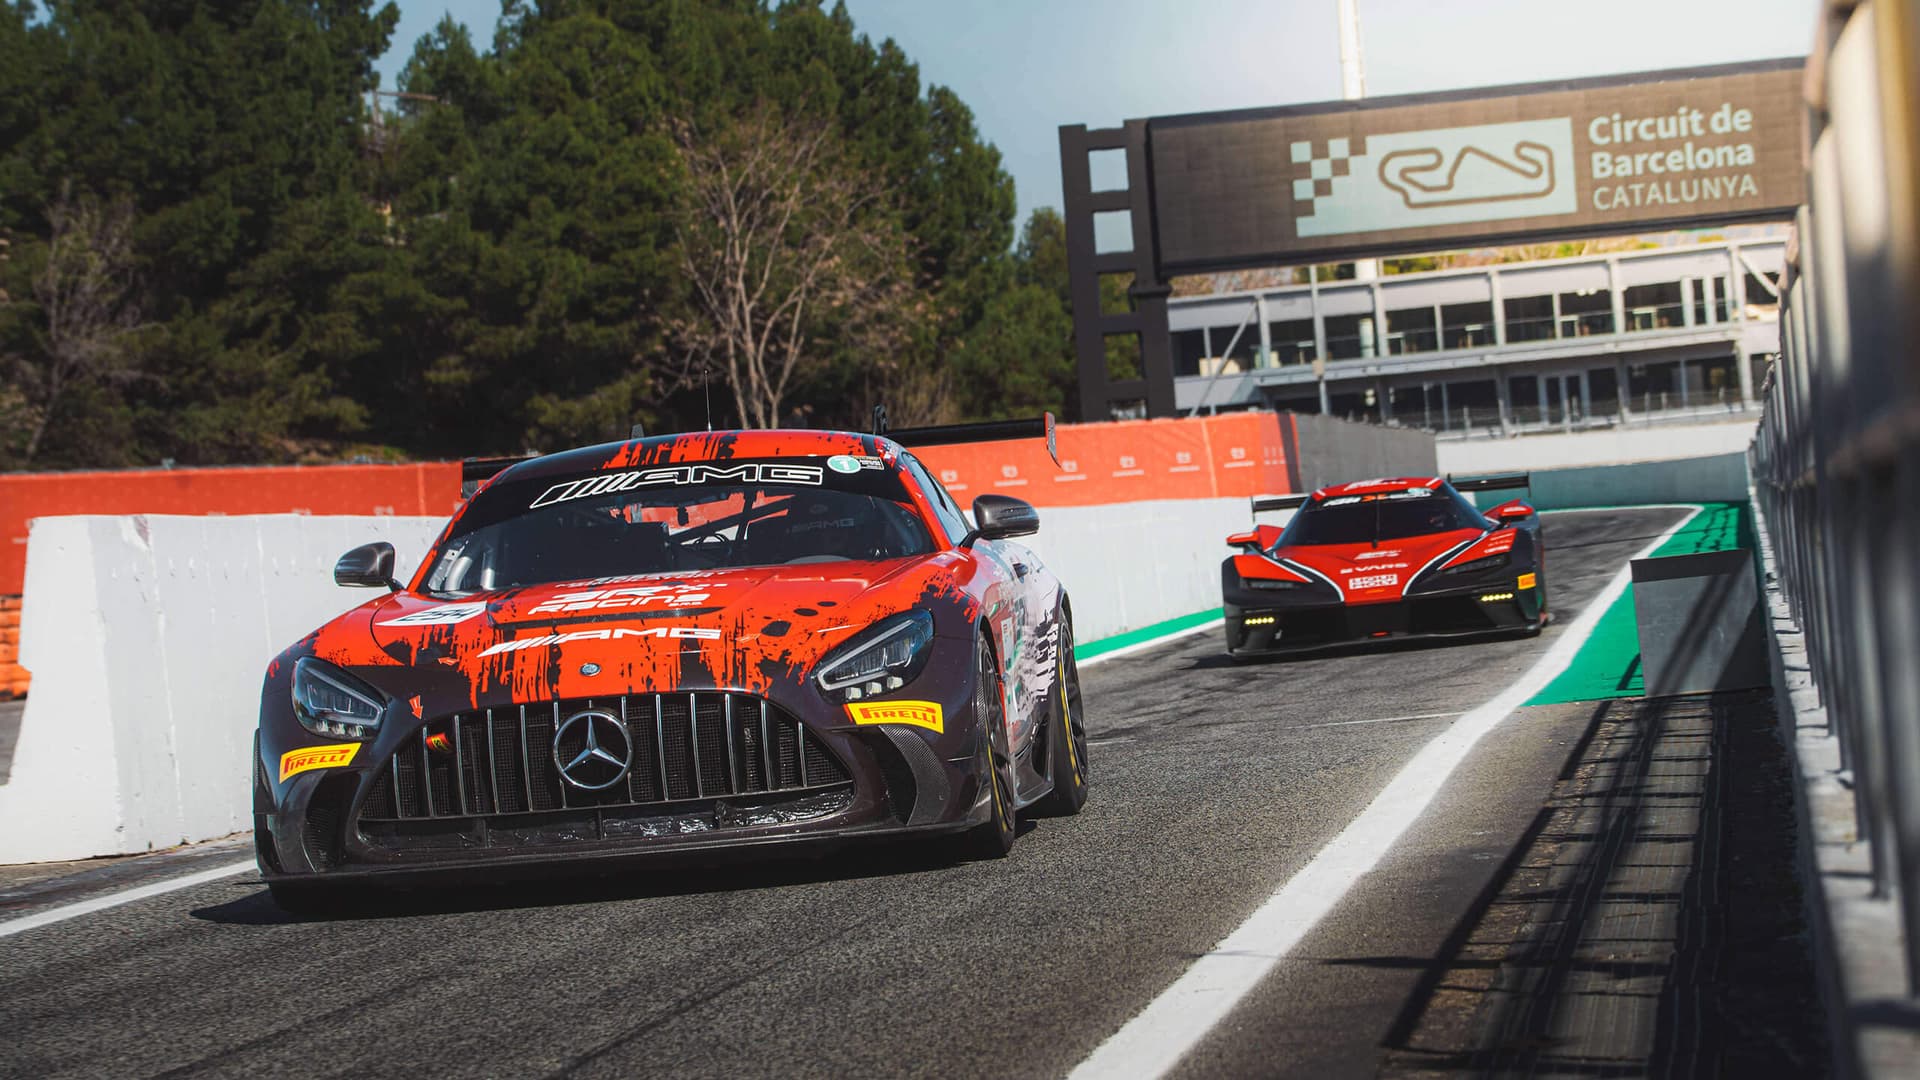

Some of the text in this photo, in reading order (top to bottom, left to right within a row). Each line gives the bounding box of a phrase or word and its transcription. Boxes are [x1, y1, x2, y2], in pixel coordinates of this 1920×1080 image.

[1588, 102, 1753, 145] Circuit de
[1591, 141, 1755, 179] Barcelona
[1592, 173, 1758, 210] CATALUNYA
[858, 705, 937, 725] PIRELLI
[283, 748, 351, 774] PIRELLI
